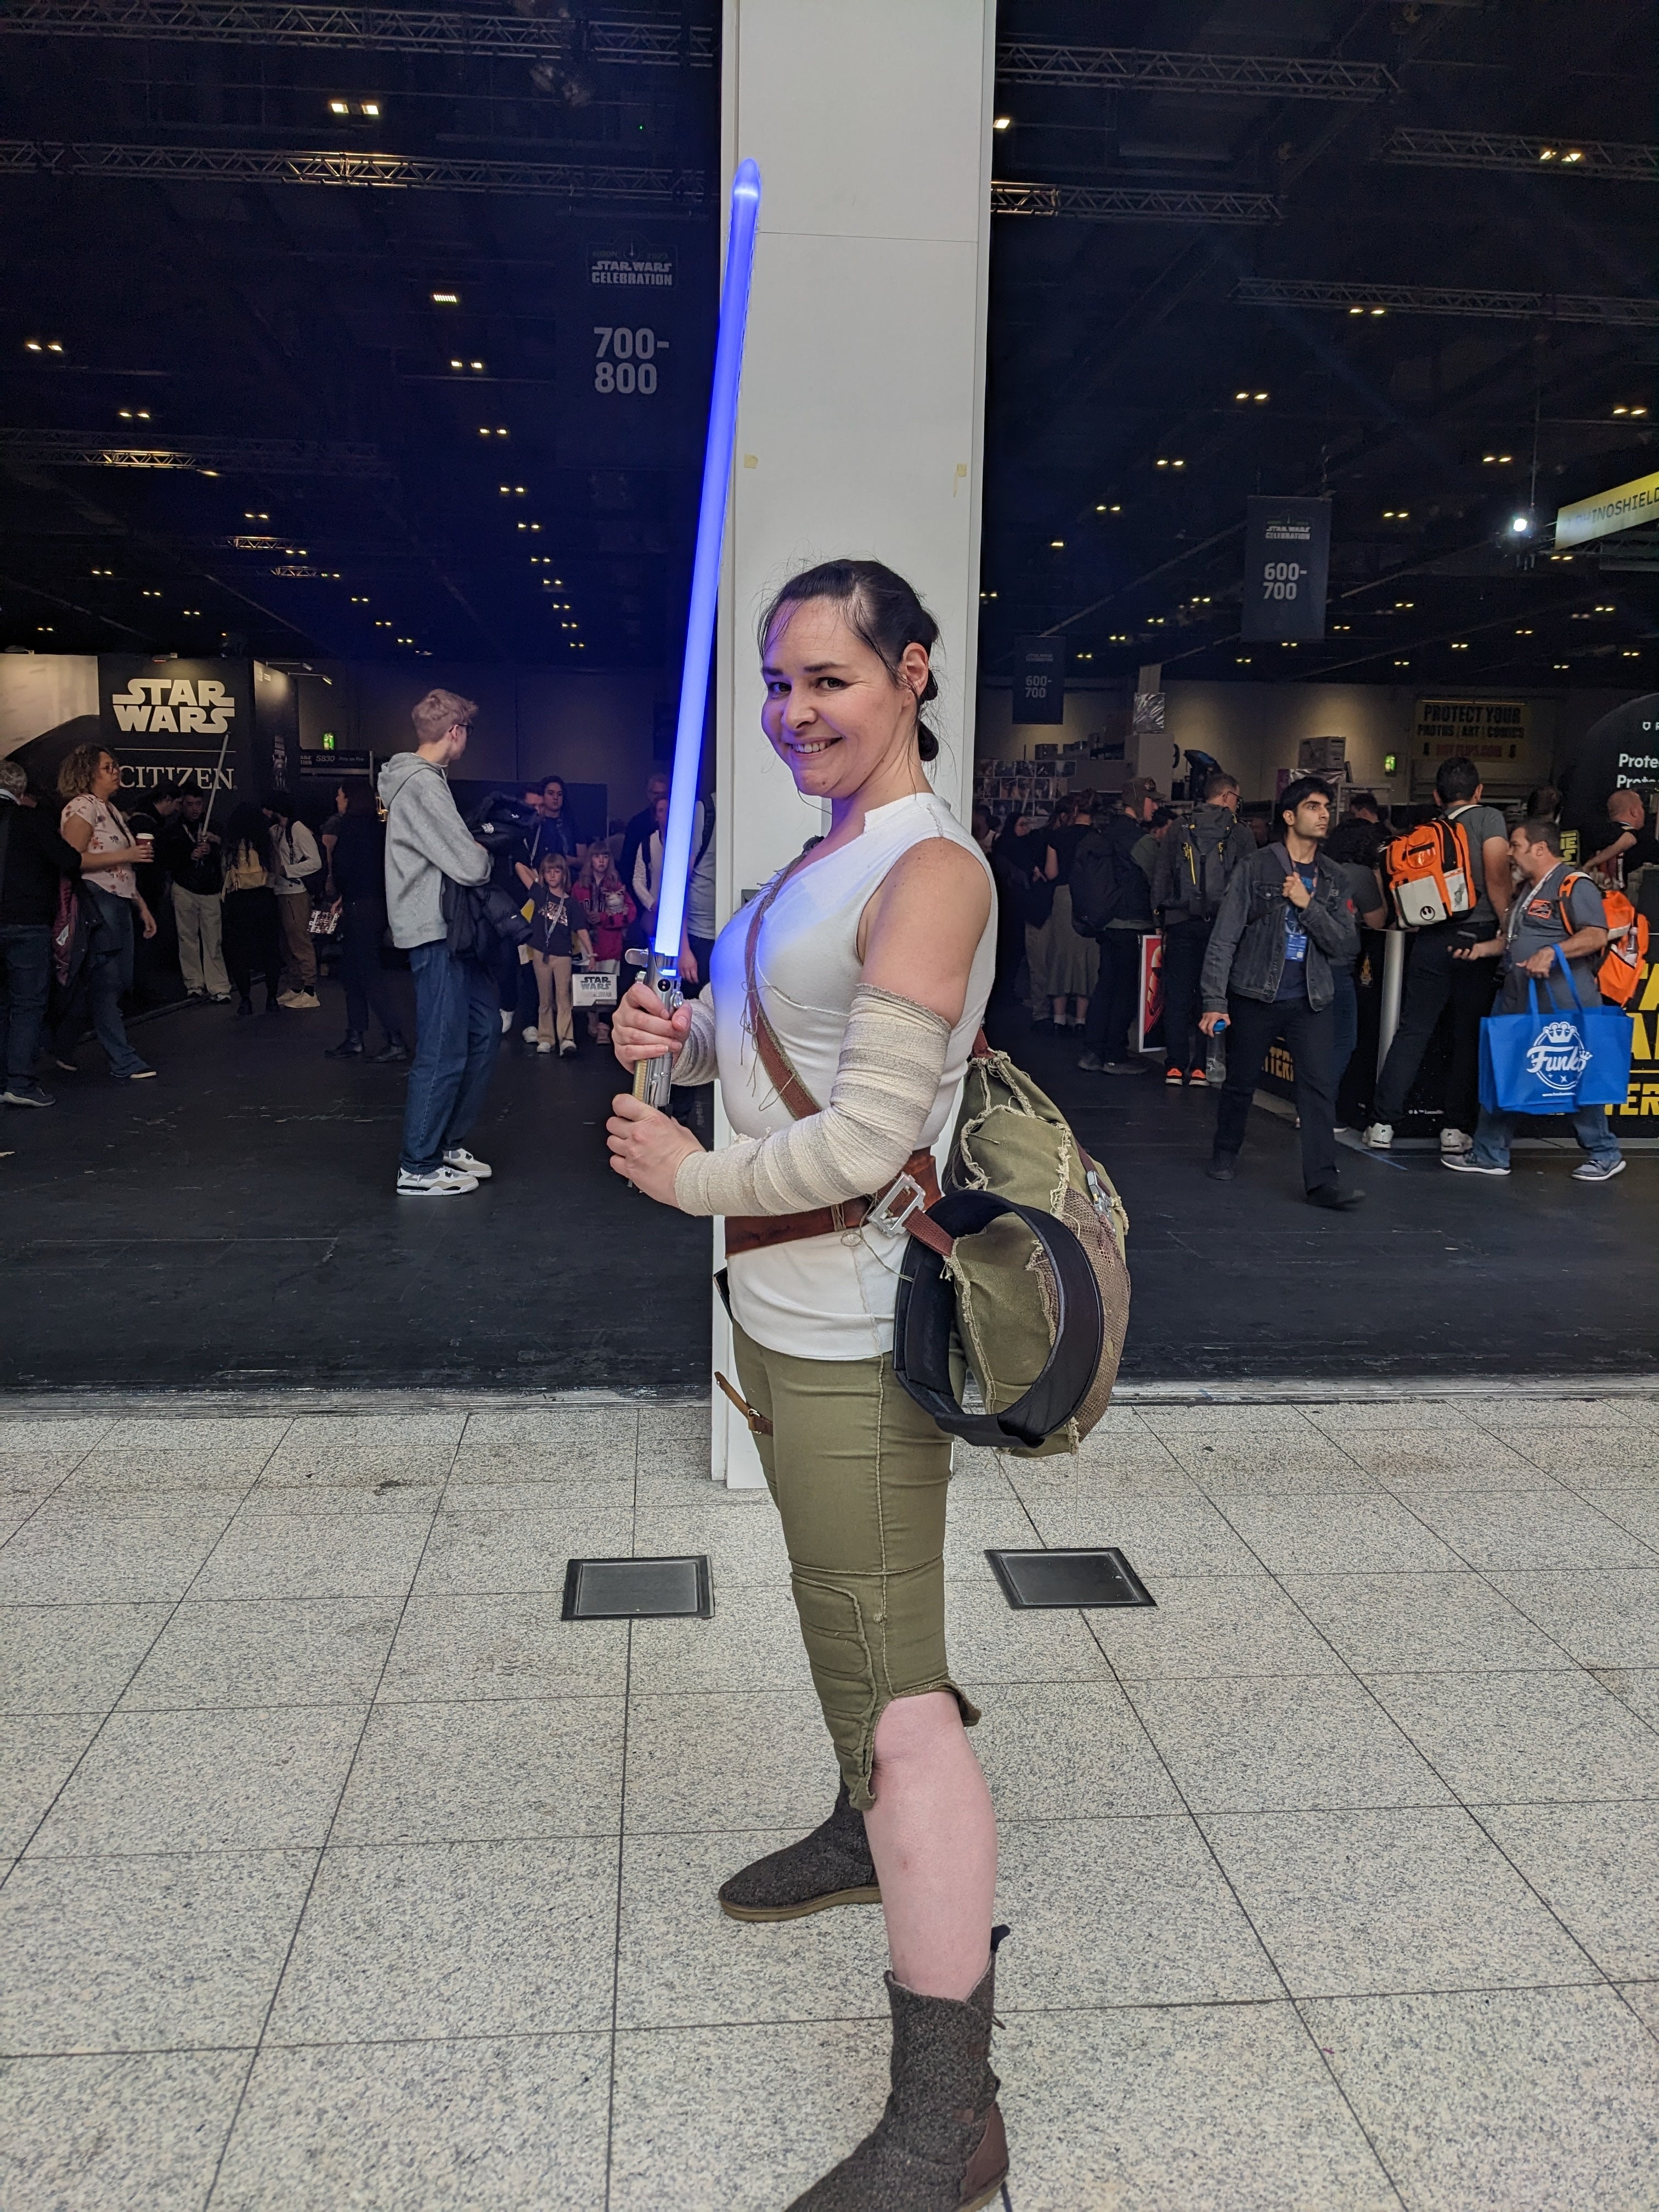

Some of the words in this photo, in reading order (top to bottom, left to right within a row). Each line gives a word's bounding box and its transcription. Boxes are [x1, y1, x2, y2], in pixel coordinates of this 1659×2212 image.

[592, 261, 632, 271] STAR
[632, 262, 672, 273] WARS
[592, 272, 672, 285] CELEBRATION
[594, 326, 669, 359] 700-
[595, 362, 657, 394] 800
[1264, 562, 1307, 581] 600-
[1263, 582, 1297, 600] 700
[1025, 675, 1052, 687] 600-
[112, 678, 235, 707] STAR
[1025, 687, 1047, 698] 700
[112, 704, 235, 733] WARS
[1424, 704, 1483, 723] PROTECT
[1486, 706, 1521, 724] YOUR
[1618, 753, 1659, 768] Prote
[119, 765, 235, 790] CITIZEN
[1526, 1046, 1587, 1073] Funko
